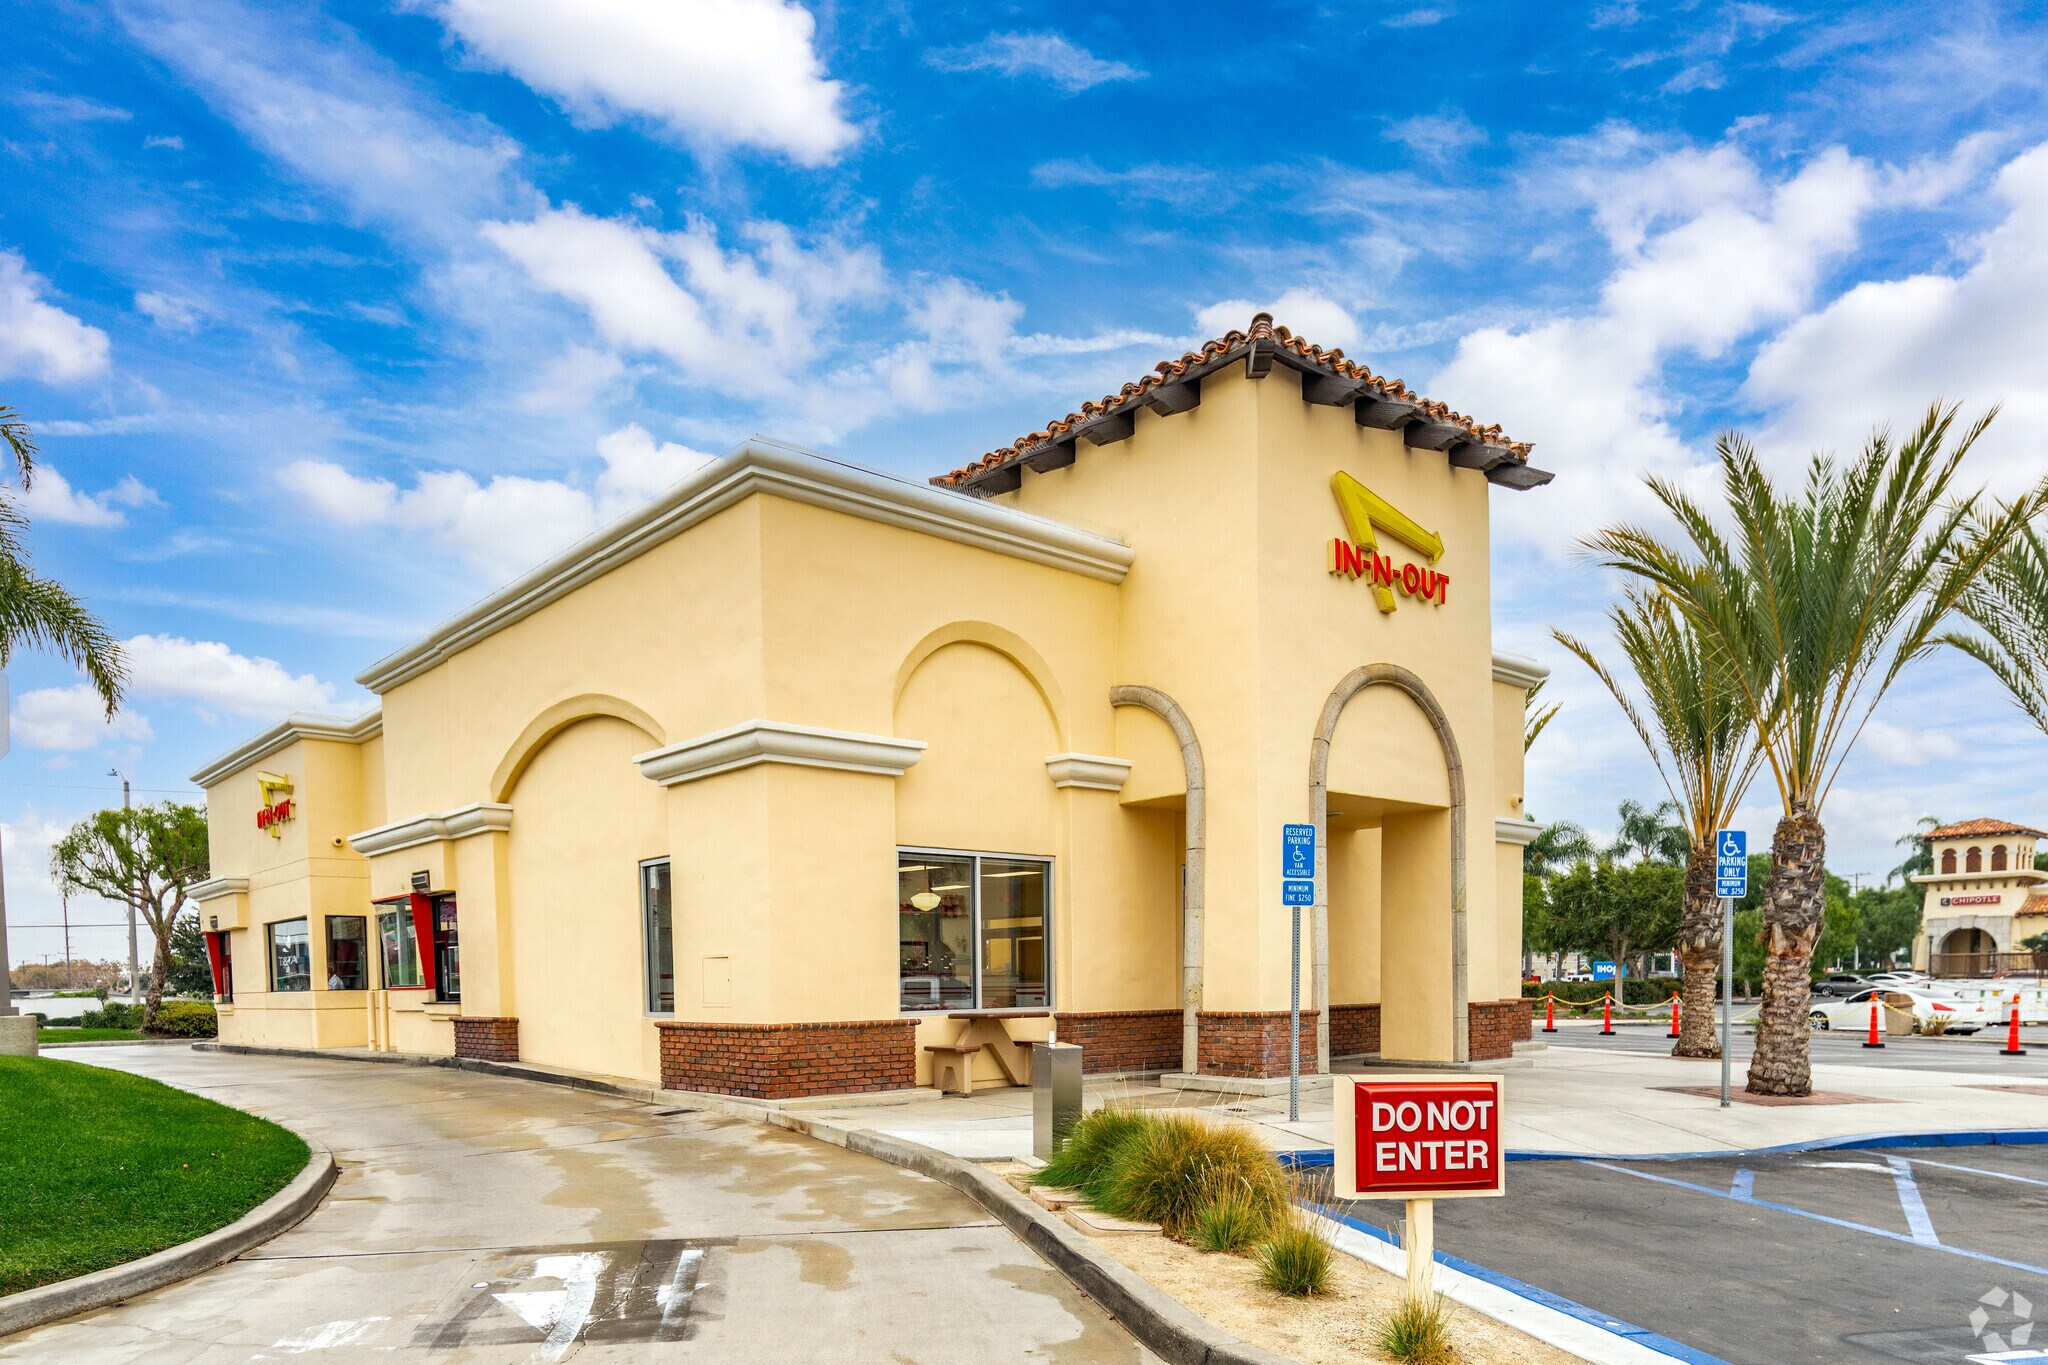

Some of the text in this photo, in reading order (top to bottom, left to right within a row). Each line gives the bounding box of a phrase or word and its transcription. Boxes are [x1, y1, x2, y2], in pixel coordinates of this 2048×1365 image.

[1332, 538, 1450, 605] IN-N-OUT
[1286, 828, 1312, 837] RESERVED
[1288, 837, 1310, 845] PARKING
[1719, 856, 1745, 866] PARKING
[1723, 867, 1740, 877] ONLY
[1285, 894, 1312, 902] FINE $250
[1952, 896, 1998, 905] CHIPOTLE
[1372, 1100, 1494, 1132] DO NOT
[1375, 1139, 1489, 1172] ENTER
